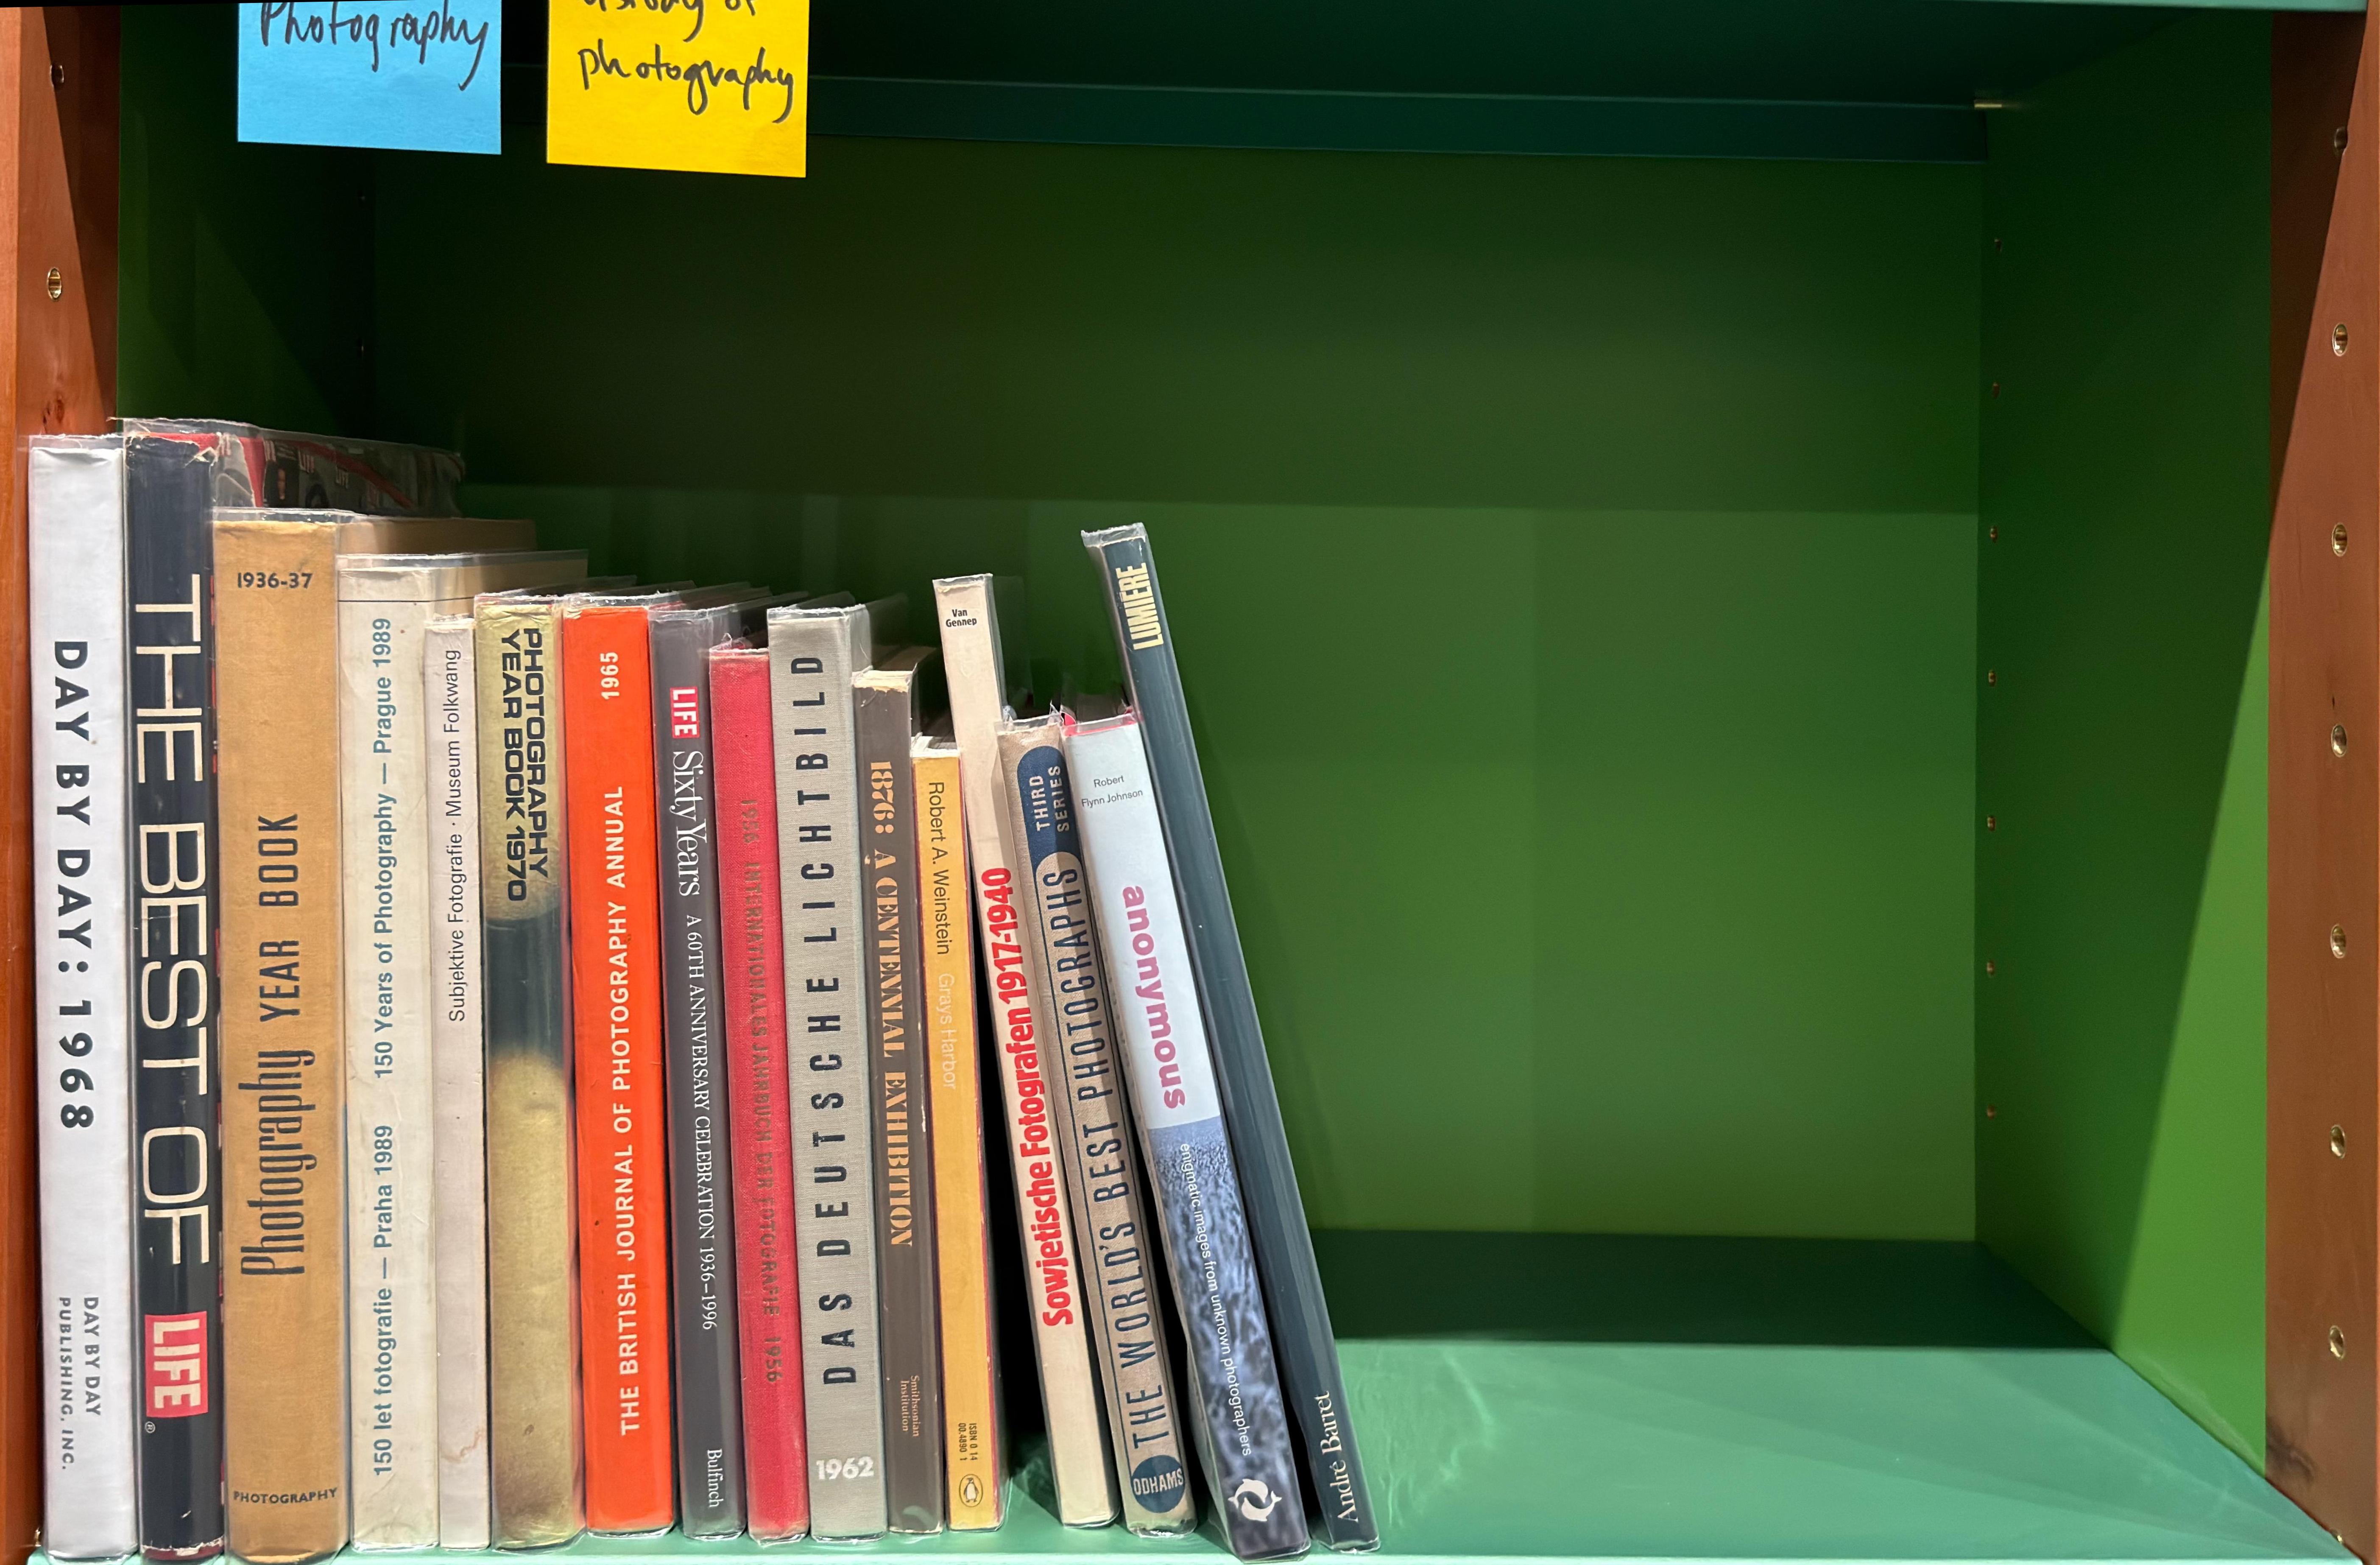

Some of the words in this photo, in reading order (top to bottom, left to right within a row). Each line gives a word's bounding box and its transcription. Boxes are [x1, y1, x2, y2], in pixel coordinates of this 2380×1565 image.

[578, 38, 794, 123] photography
[237, 573, 313, 589] 1936-37
[951, 609, 968, 618] Van
[373, 618, 391, 668] 1989
[945, 616, 977, 628] Gennep
[55, 641, 89, 741] DAY
[136, 574, 203, 783] THE
[443, 649, 461, 733] Folkwang
[500, 629, 523, 719] YEAR
[600, 652, 619, 700] 1965
[374, 676, 397, 754] Prague
[672, 689, 698, 736] LIFE
[446, 742, 461, 816] Museum
[504, 728, 526, 820] BOOK
[523, 628, 549, 879] PHOTOGRAPHY
[1094, 774, 1124, 788] Robert
[56, 764, 90, 825] BY
[670, 751, 704, 822] Sixty
[791, 657, 837, 943] LICHTBILD
[871, 761, 896, 834] 1876:
[928, 782, 945, 842] Robert
[1030, 775, 1051, 832] THIRD
[1049, 765, 1070, 833] SERIES
[1081, 795, 1105, 808] Flynn
[1107, 789, 1144, 803] Johnson
[258, 813, 299, 906] BOOK
[374, 794, 397, 933] Photography
[506, 825, 527, 901] 1970
[605, 786, 624, 888] ANNUAL
[677, 819, 708, 897] Years
[873, 849, 896, 869] A
[932, 847, 949, 865] A.
[58, 849, 92, 972] DAY:
[447, 834, 466, 923] Fotografie
[686, 915, 702, 927] A
[934, 869, 949, 955] Weinstein
[981, 867, 1028, 1005] 1917-1940
[140, 823, 207, 1095] BEST
[259, 940, 300, 1022] YEAR
[374, 942, 393, 963] of
[449, 930, 468, 1021] Subjektive
[687, 933, 705, 979] 60TH
[875, 878, 905, 1058] CENTENNIAL
[1042, 868, 1113, 1101] PHOTOGRAPHS
[374, 973, 393, 1033] Years
[608, 901, 631, 1091] PHOTOGRAPHY
[937, 973, 955, 1024] Grays
[1122, 885, 1186, 1109] anonymous
[59, 999, 94, 1128] 1968
[374, 1042, 393, 1079] 150
[689, 984, 710, 1111] ANNIVERSARY
[940, 1029, 957, 1090] Harbor
[1006, 1007, 1054, 1158] Fotografen
[374, 1125, 393, 1174] 1989
[613, 1103, 632, 1133] OF
[806, 977, 851, 1257] DEUTSCHE
[238, 1050, 317, 1276] Photography
[695, 1116, 715, 1239] CELEBRATION
[884, 1071, 913, 1247] EXHIBITION
[1083, 1121, 1130, 1203] BEST
[1180, 1143, 1201, 1208] enigmatic
[143, 1126, 209, 1264] OF
[374, 1184, 392, 1248] Praha
[614, 1145, 636, 1261] JOURNAL
[1027, 1158, 1074, 1326] Sowjetische
[1194, 1209, 1211, 1258] images
[1203, 1260, 1218, 1292] from
[84, 1297, 99, 1337] DAY
[374, 1288, 396, 1396] fotografie
[617, 1273, 639, 1375] BRITISH
[818, 1294, 857, 1384] DAS
[1211, 1294, 1231, 1354] unknown
[85, 1344, 100, 1369] BY
[153, 1319, 201, 1409] LIFE
[765, 1337, 784, 1383] 1956
[85, 1377, 101, 1416] DAY
[374, 1403, 392, 1431] let
[621, 1386, 640, 1435] THE
[901, 1381, 910, 1432] Institution
[910, 1375, 921, 1437] Smithsonian
[1126, 1384, 1170, 1449] THE
[1220, 1357, 1251, 1456] photographers
[1314, 1390, 1343, 1455] Barret
[61, 1430, 74, 1470] INC.
[374, 1440, 392, 1475] 150
[969, 1423, 977, 1441] ISBN
[970, 1452, 978, 1461] 14
[233, 1487, 338, 1505] PHOTOGRAPHY
[706, 1448, 724, 1508] Bulfinch
[816, 1456, 874, 1480] 1962
[1132, 1467, 1184, 1496] ODHAMS
[1330, 1460, 1359, 1523] André
